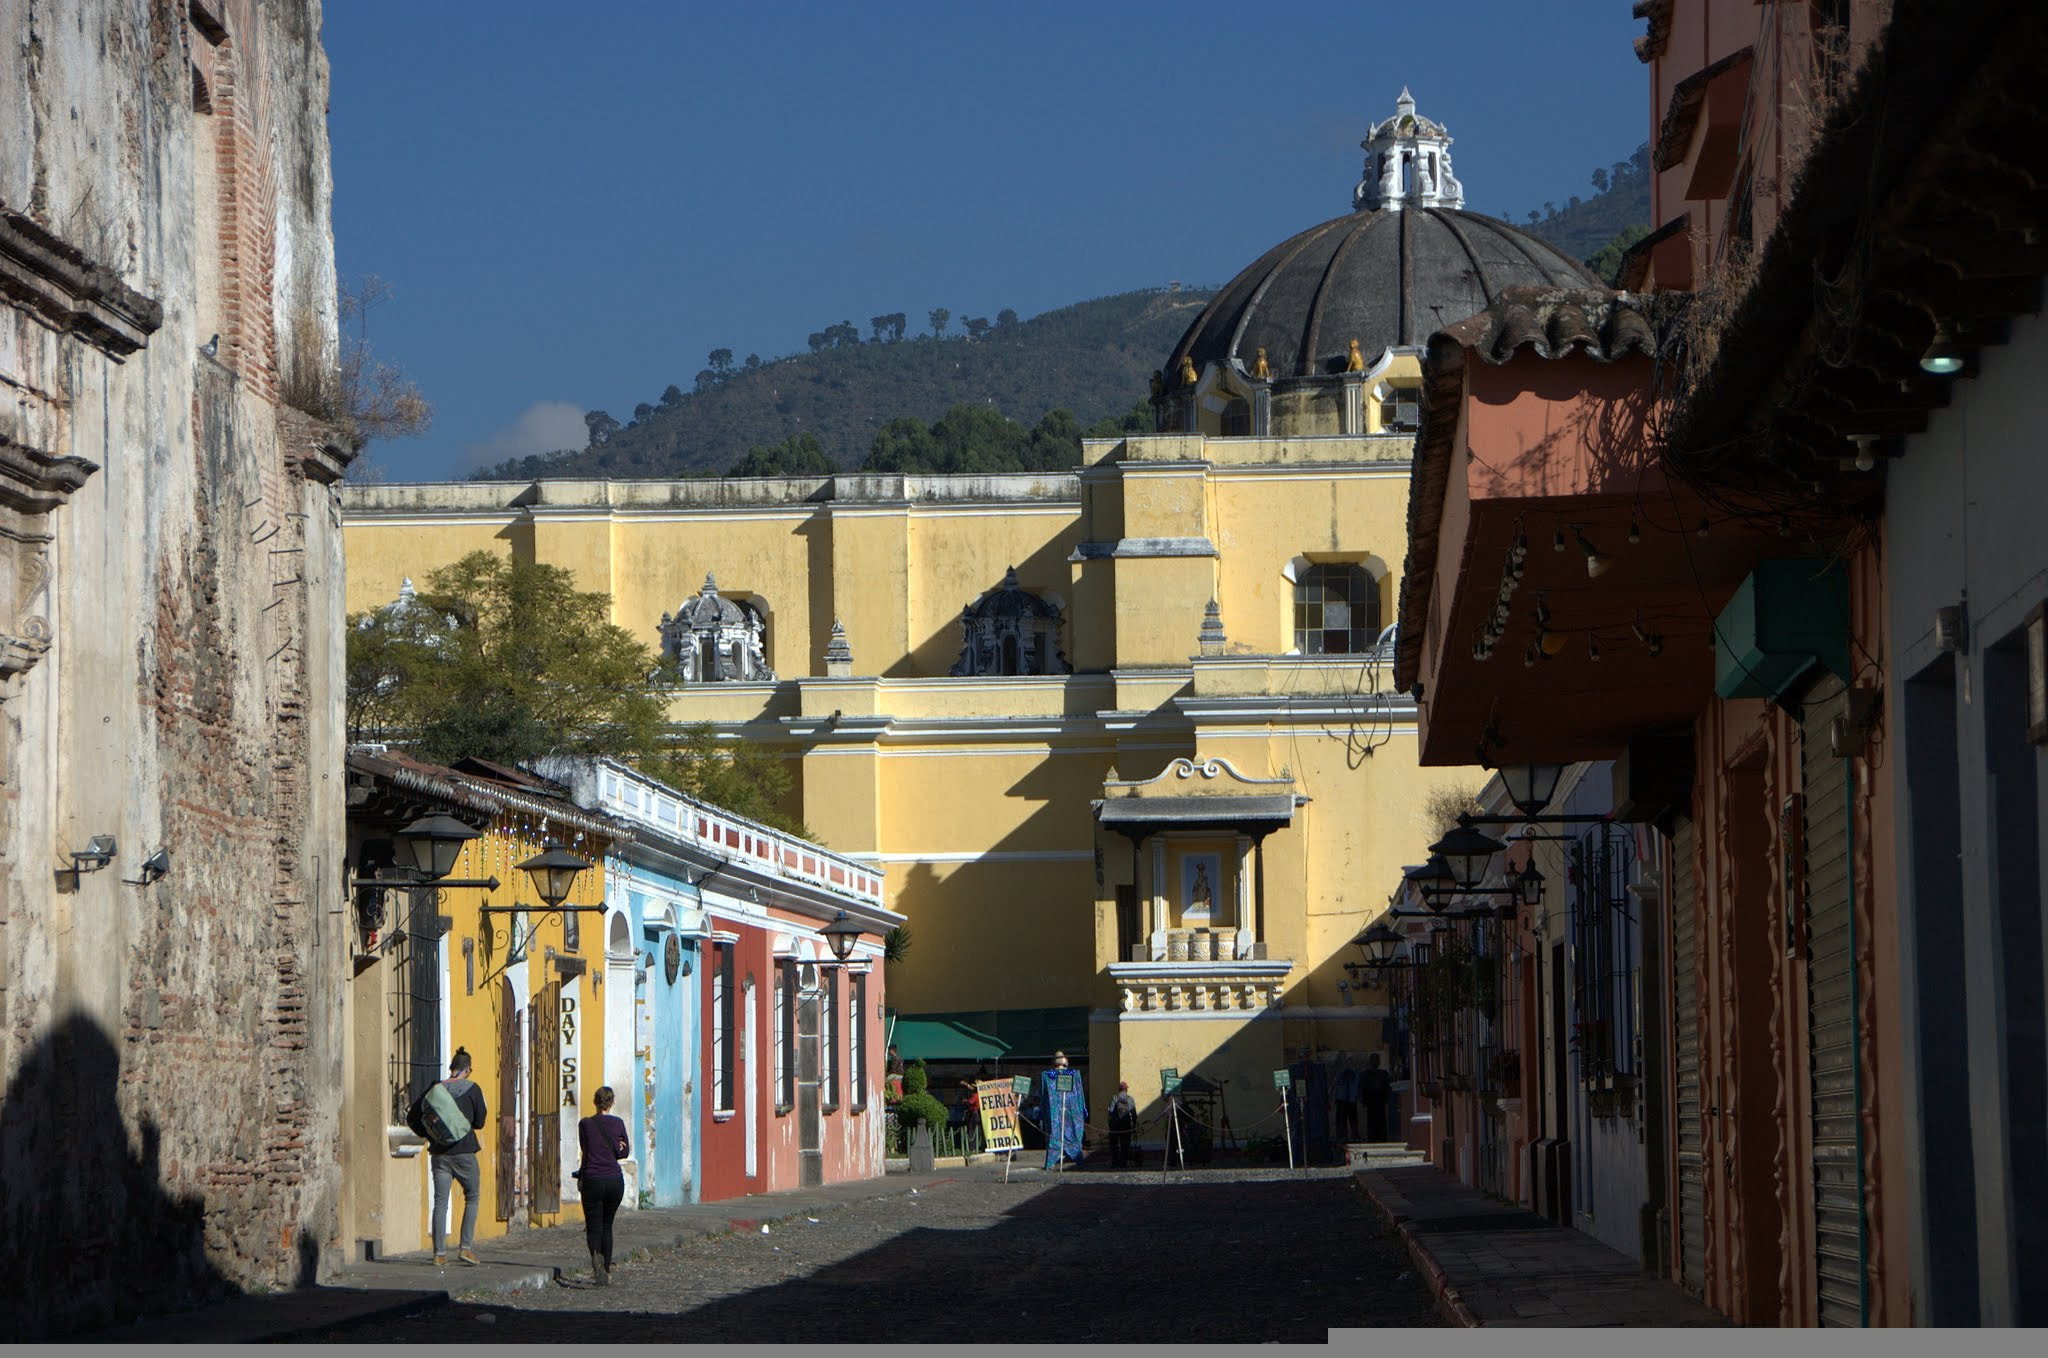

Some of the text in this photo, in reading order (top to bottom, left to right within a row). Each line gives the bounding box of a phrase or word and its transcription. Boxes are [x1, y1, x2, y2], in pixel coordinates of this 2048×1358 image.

[561, 997, 577, 1106] DAY SPA
[980, 1093, 1014, 1110] FERIA
[990, 1115, 1012, 1130] DEL
